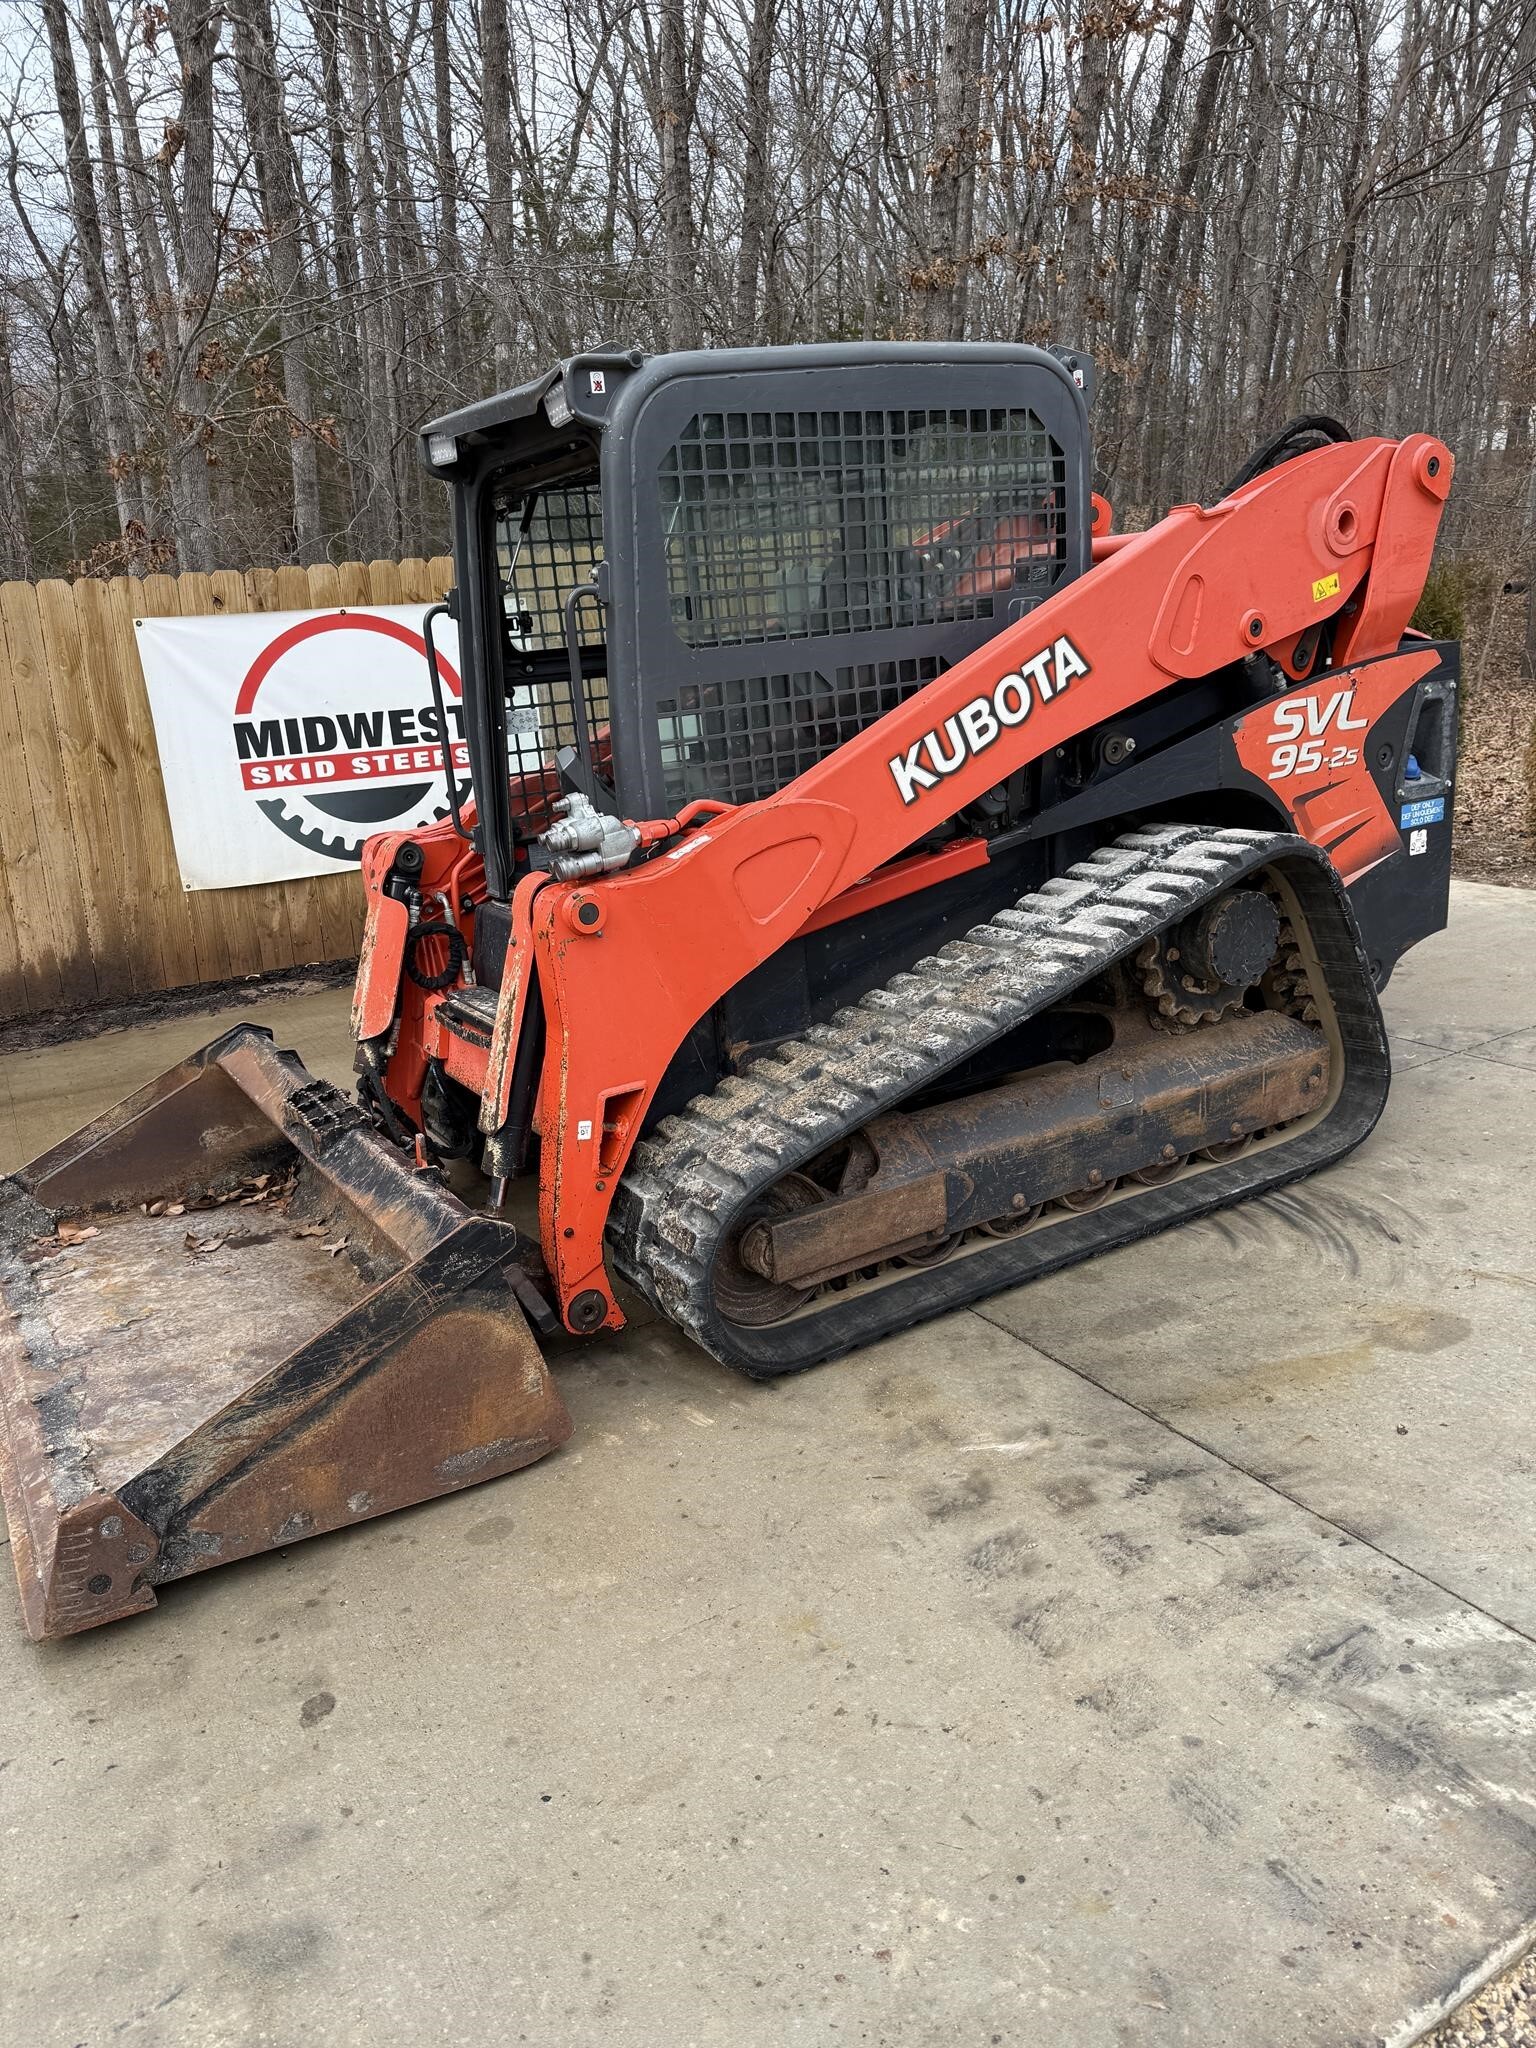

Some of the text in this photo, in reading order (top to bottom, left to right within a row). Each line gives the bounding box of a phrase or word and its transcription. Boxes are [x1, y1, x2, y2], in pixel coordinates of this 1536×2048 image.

[887, 635, 1090, 805] KUBOTA
[1266, 690, 1369, 744] SVL
[233, 704, 467, 760] MIDWEST
[250, 759, 336, 785] SKID
[1402, 812, 1411, 821] DEF
[1411, 801, 1434, 811] DEF ONLY
[1424, 814, 1434, 823] DEF
